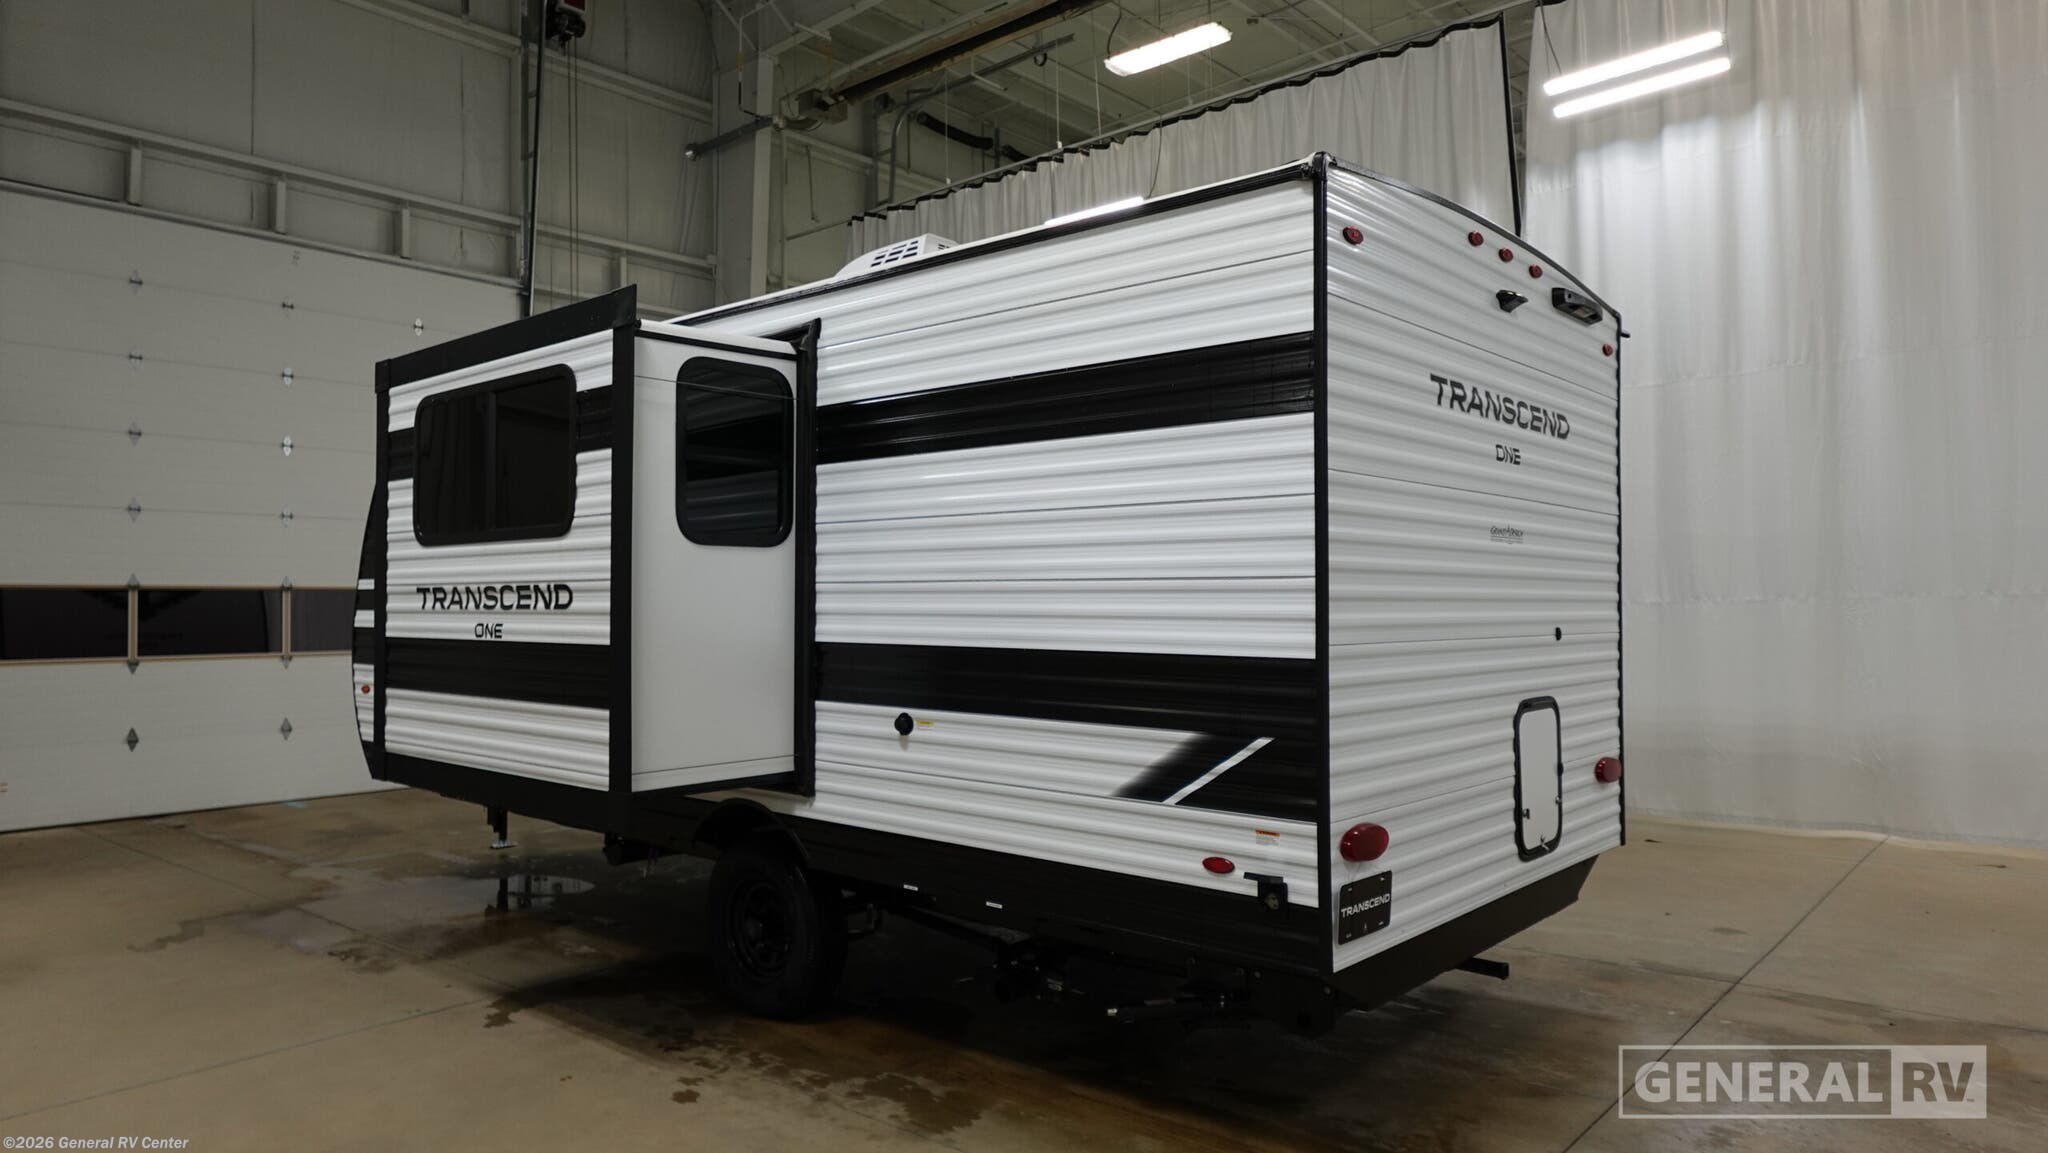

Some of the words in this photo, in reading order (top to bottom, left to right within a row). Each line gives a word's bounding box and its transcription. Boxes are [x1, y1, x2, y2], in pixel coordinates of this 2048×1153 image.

[1430, 373, 1570, 439] TRANSCEND
[1496, 444, 1521, 465] ONE
[417, 584, 573, 610] TRANSCEND
[475, 623, 503, 638] ONE
[1341, 893, 1391, 918] TRANSCEND
